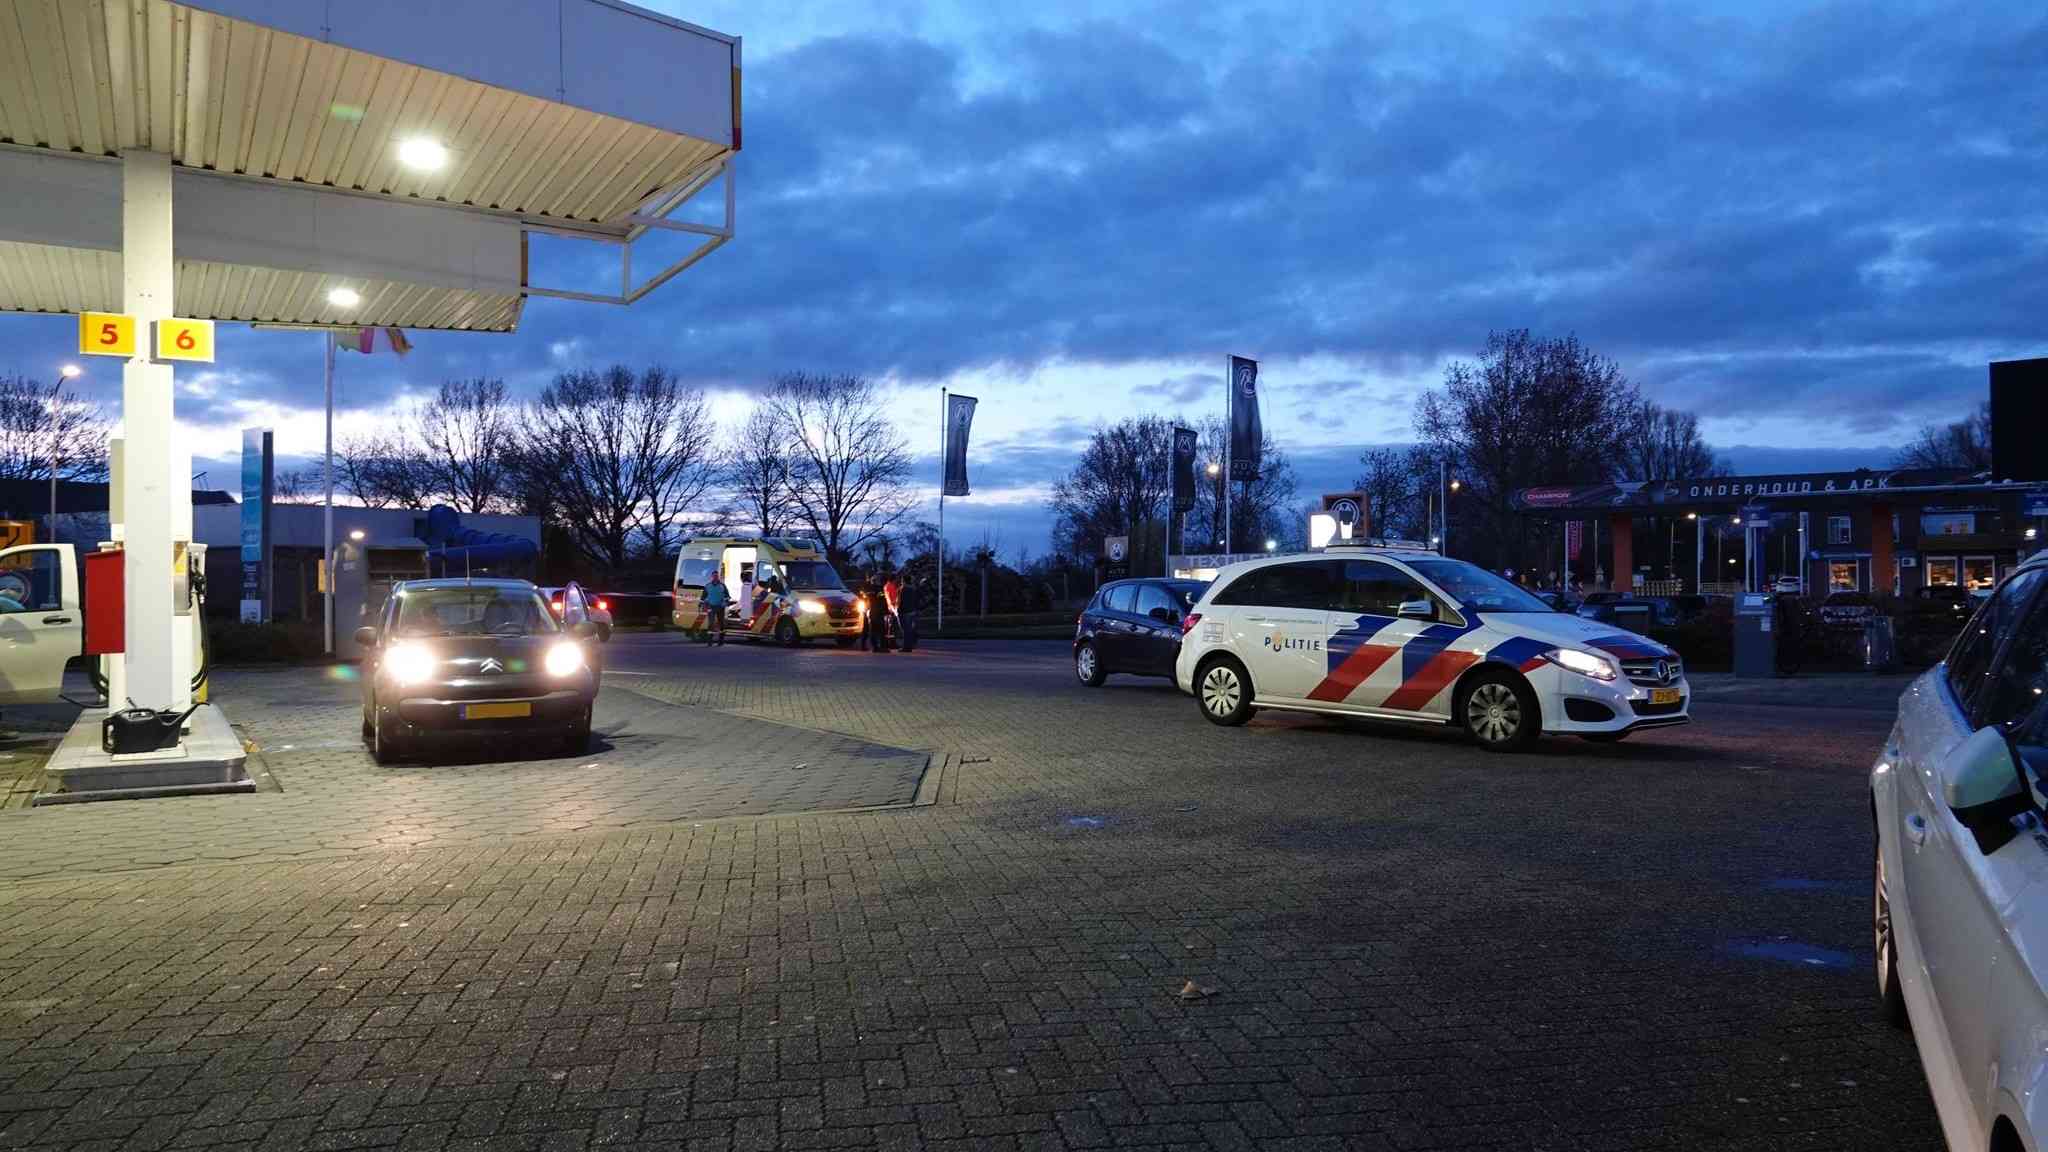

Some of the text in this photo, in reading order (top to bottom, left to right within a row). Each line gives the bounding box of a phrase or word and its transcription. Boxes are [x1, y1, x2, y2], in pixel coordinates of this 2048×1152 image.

[100, 323, 118, 345] 5
[176, 329, 195, 350] 6
[1690, 478, 1889, 497] ONDERHOUD & APK
[1264, 636, 1320, 652] POLITIE
